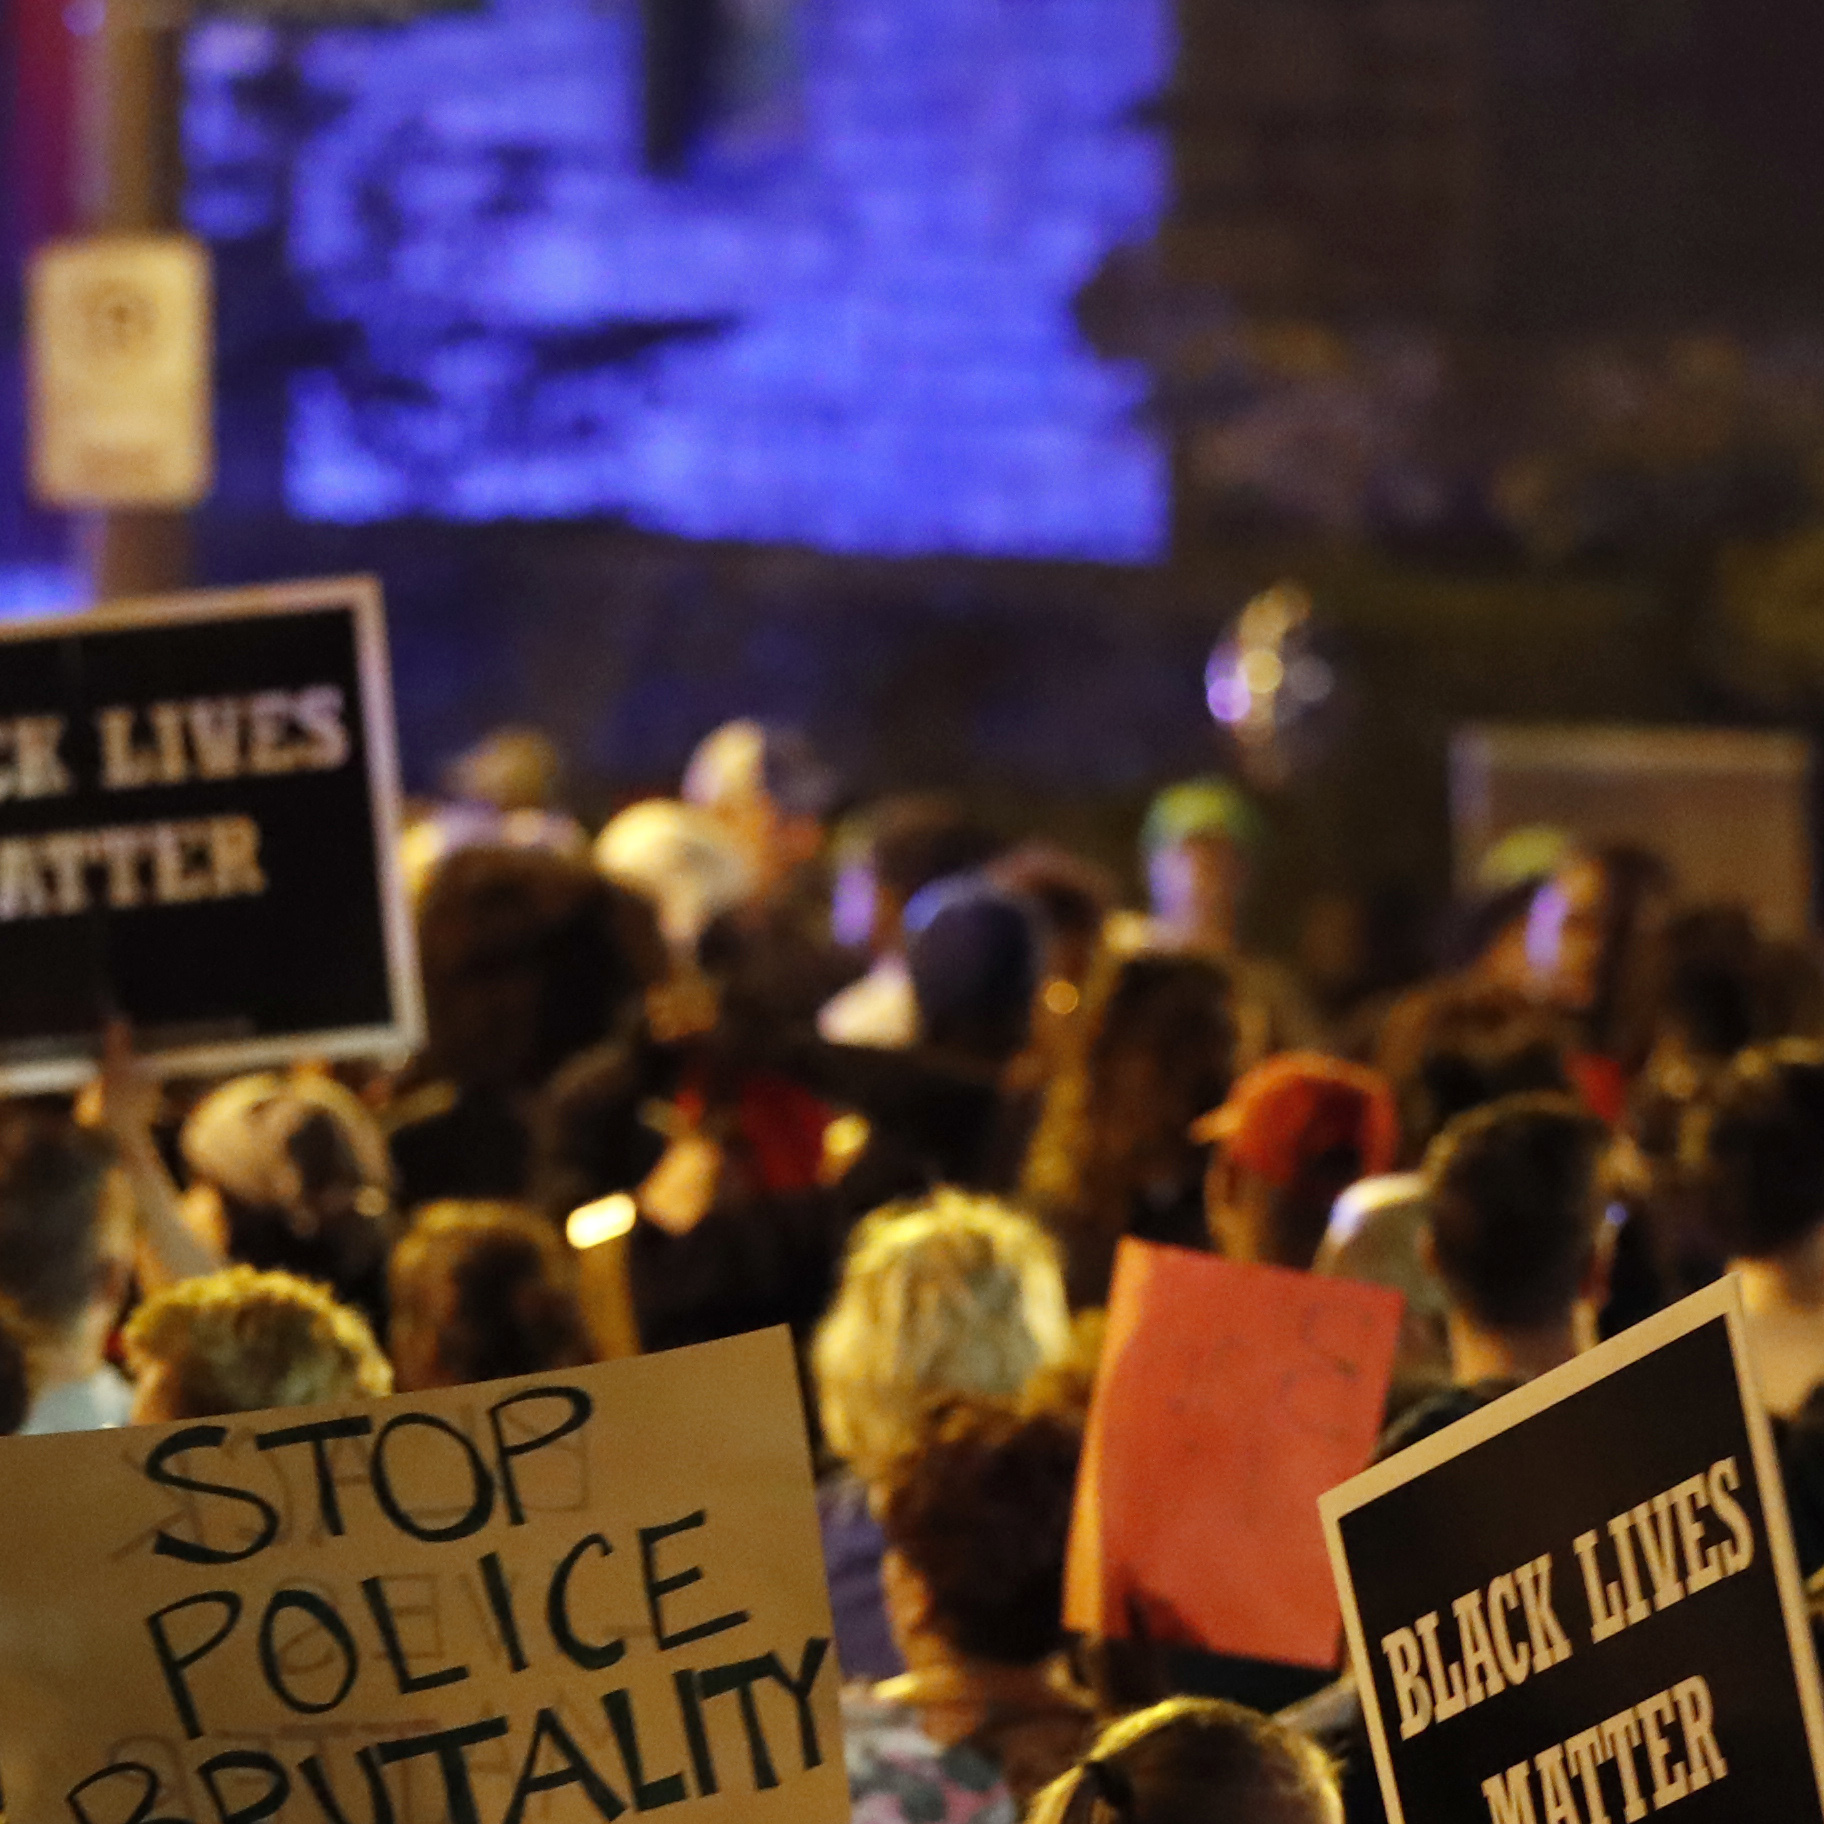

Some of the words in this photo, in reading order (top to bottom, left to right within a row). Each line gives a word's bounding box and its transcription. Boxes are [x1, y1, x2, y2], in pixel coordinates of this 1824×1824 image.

[98, 685, 351, 789] LIVES
[143, 1385, 592, 1565] STOP
[146, 1510, 750, 1742] POLICE
[1381, 1552, 1573, 1741] BLACK
[1573, 1457, 1754, 1644] LIVES
